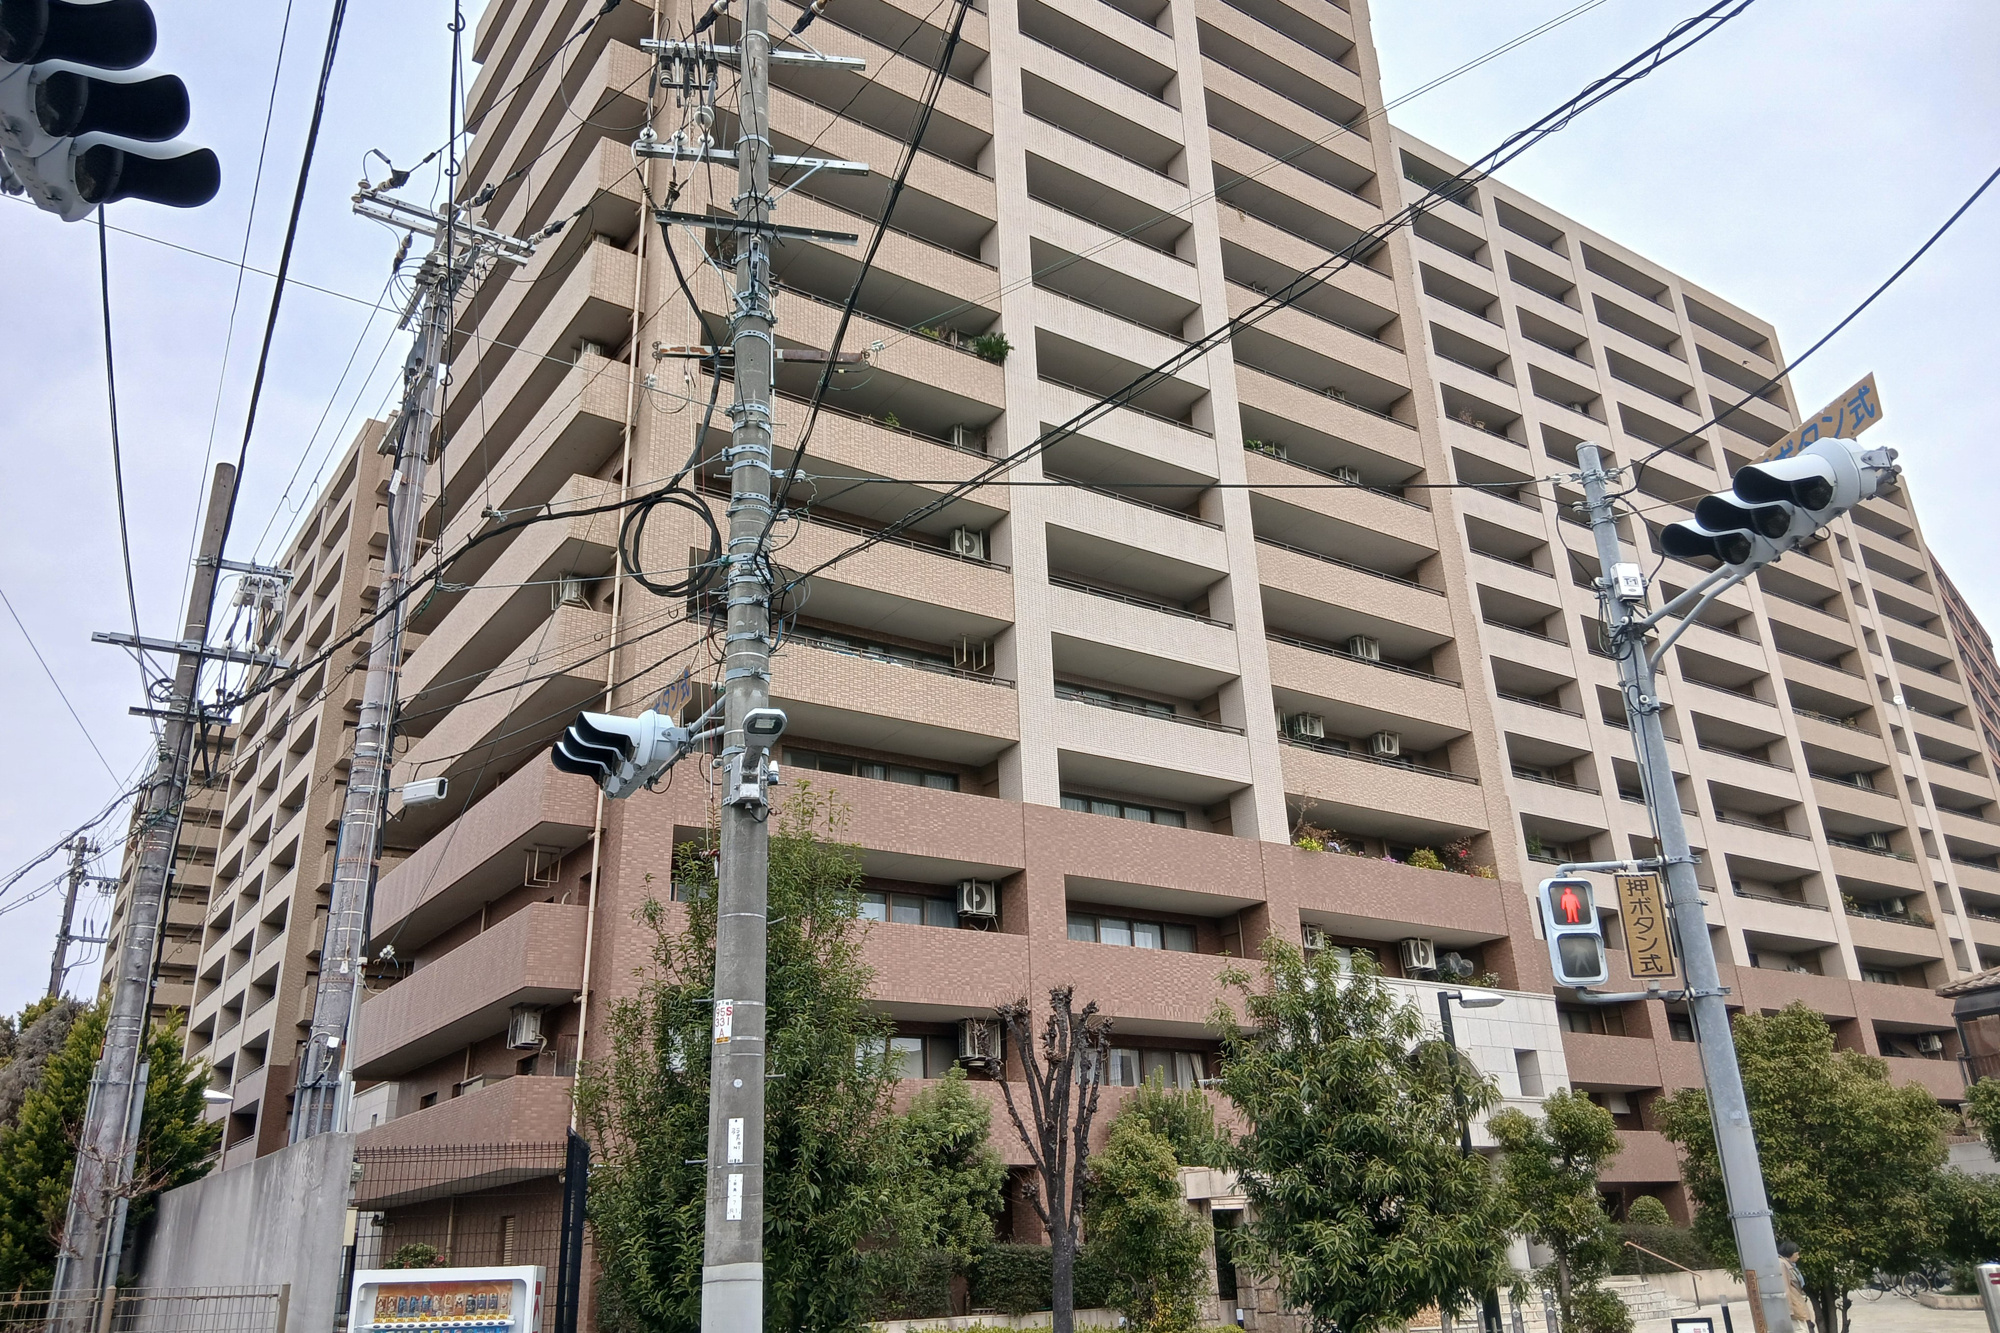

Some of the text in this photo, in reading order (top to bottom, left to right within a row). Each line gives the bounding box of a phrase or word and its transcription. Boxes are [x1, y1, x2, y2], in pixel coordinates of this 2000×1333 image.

[1626, 879, 1663, 973] 押ボタン式
